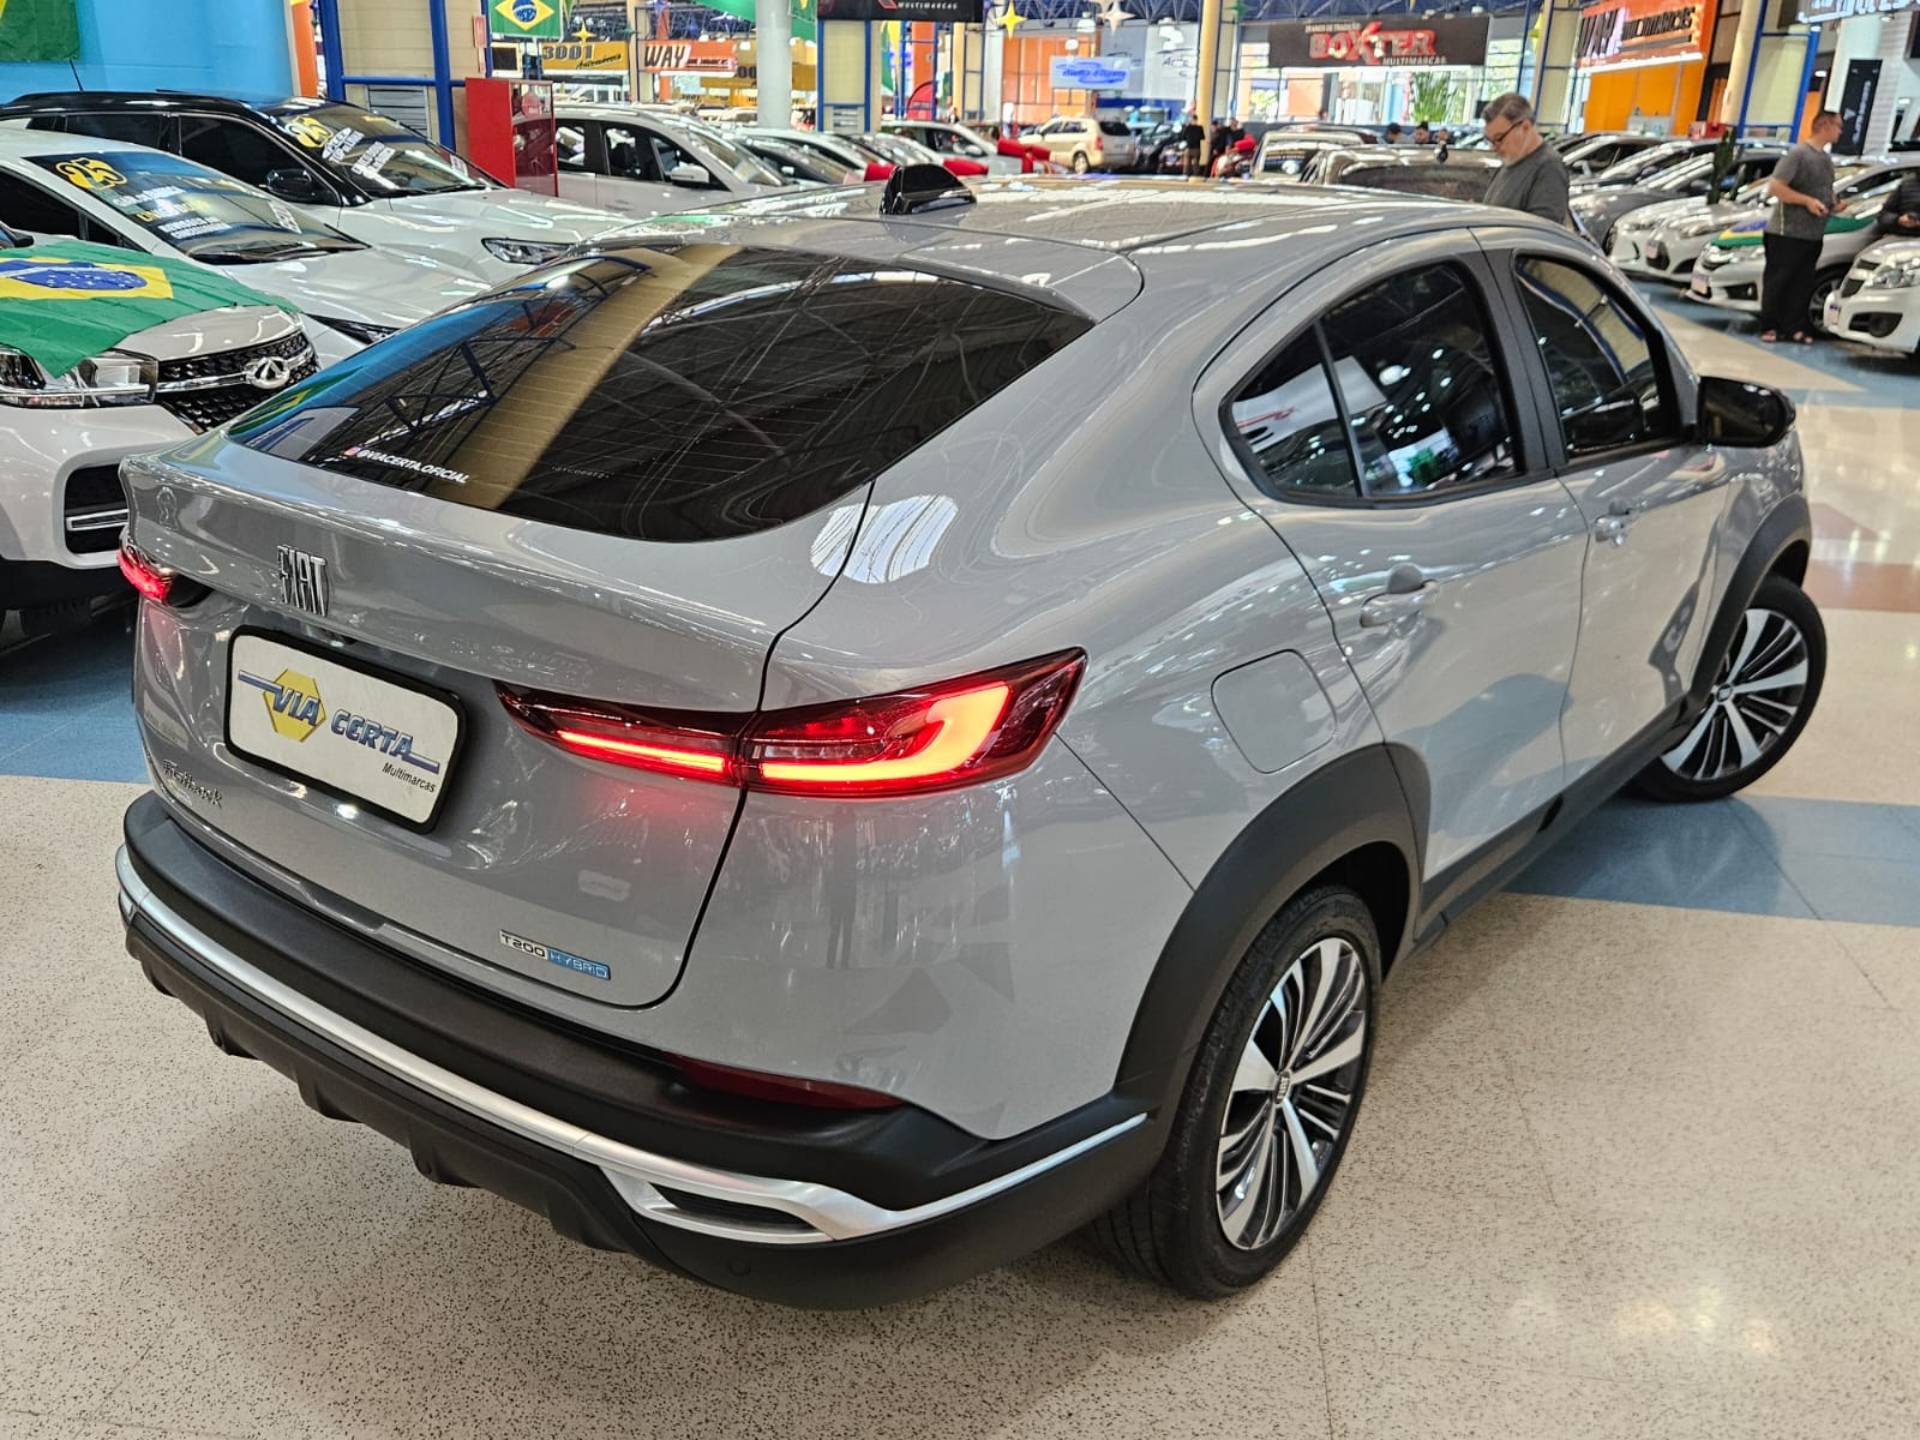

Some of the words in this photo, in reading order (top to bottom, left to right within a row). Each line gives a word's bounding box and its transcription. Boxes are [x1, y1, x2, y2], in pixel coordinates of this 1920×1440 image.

[542, 46, 592, 60] 3001
[1309, 21, 1437, 64] BOXTER
[1576, 8, 1620, 58] WAY
[644, 46, 686, 68] WAY
[56, 157, 127, 191] 25
[277, 545, 327, 617] FIAT
[331, 708, 418, 762] CERTA
[382, 762, 436, 793] Multimarcas
[501, 933, 546, 958] T200
[550, 950, 608, 978] HYBRID
